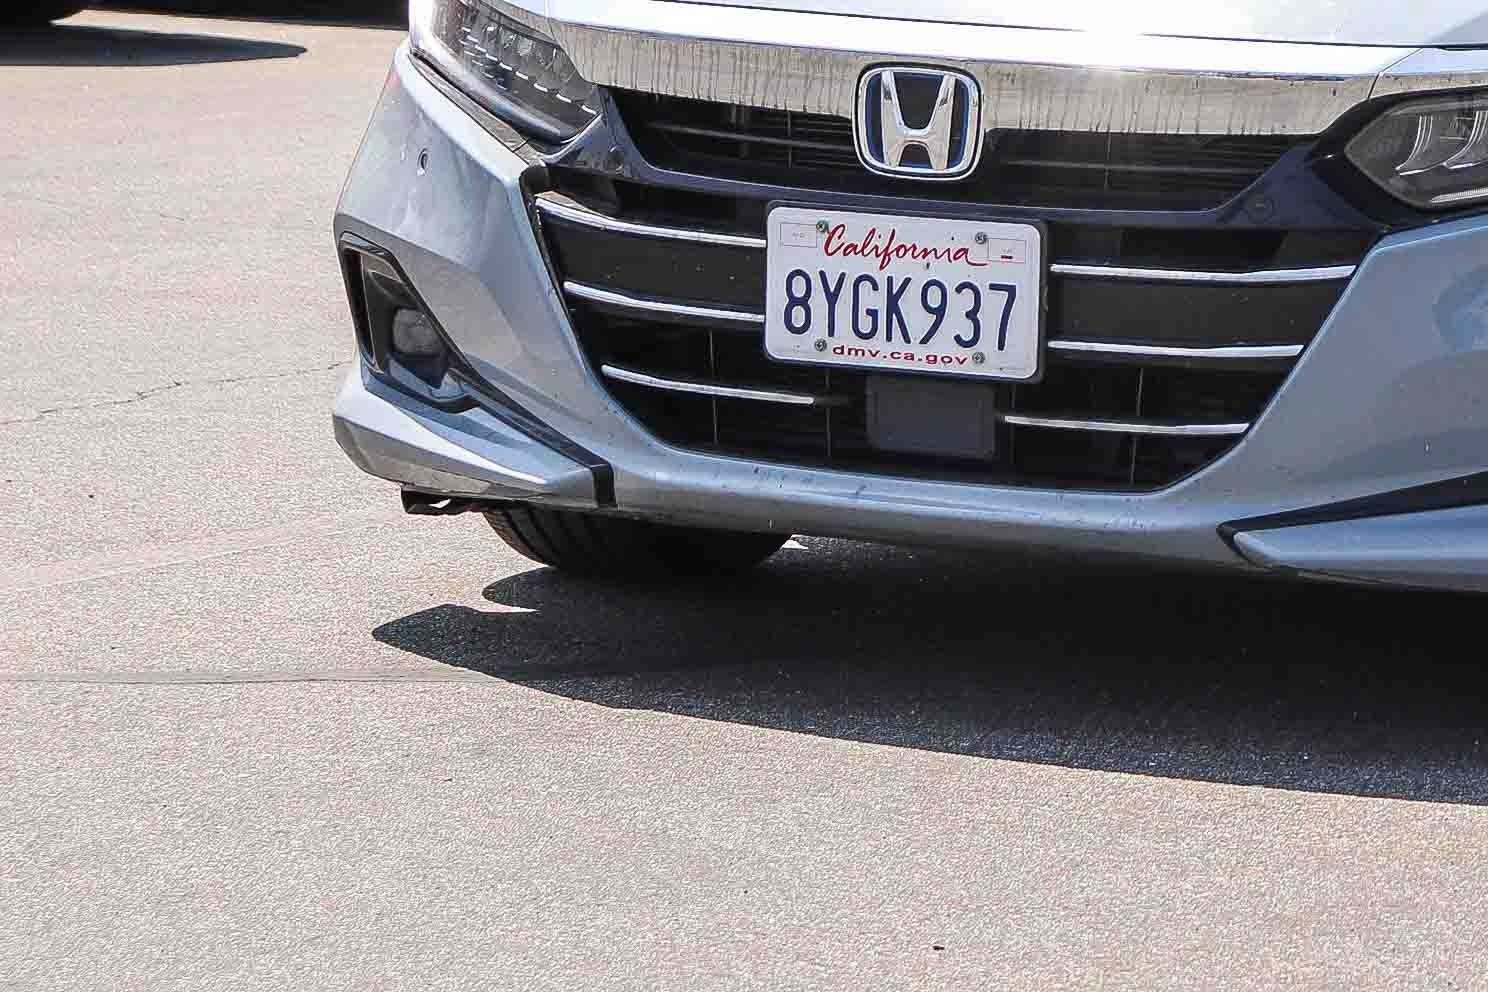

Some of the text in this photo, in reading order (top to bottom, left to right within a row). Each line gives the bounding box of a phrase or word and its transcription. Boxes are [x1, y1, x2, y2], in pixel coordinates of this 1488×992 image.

[823, 223, 988, 271] California
[783, 268, 1017, 352] 8YGK937
[832, 344, 969, 366] dmv.ca.gov
